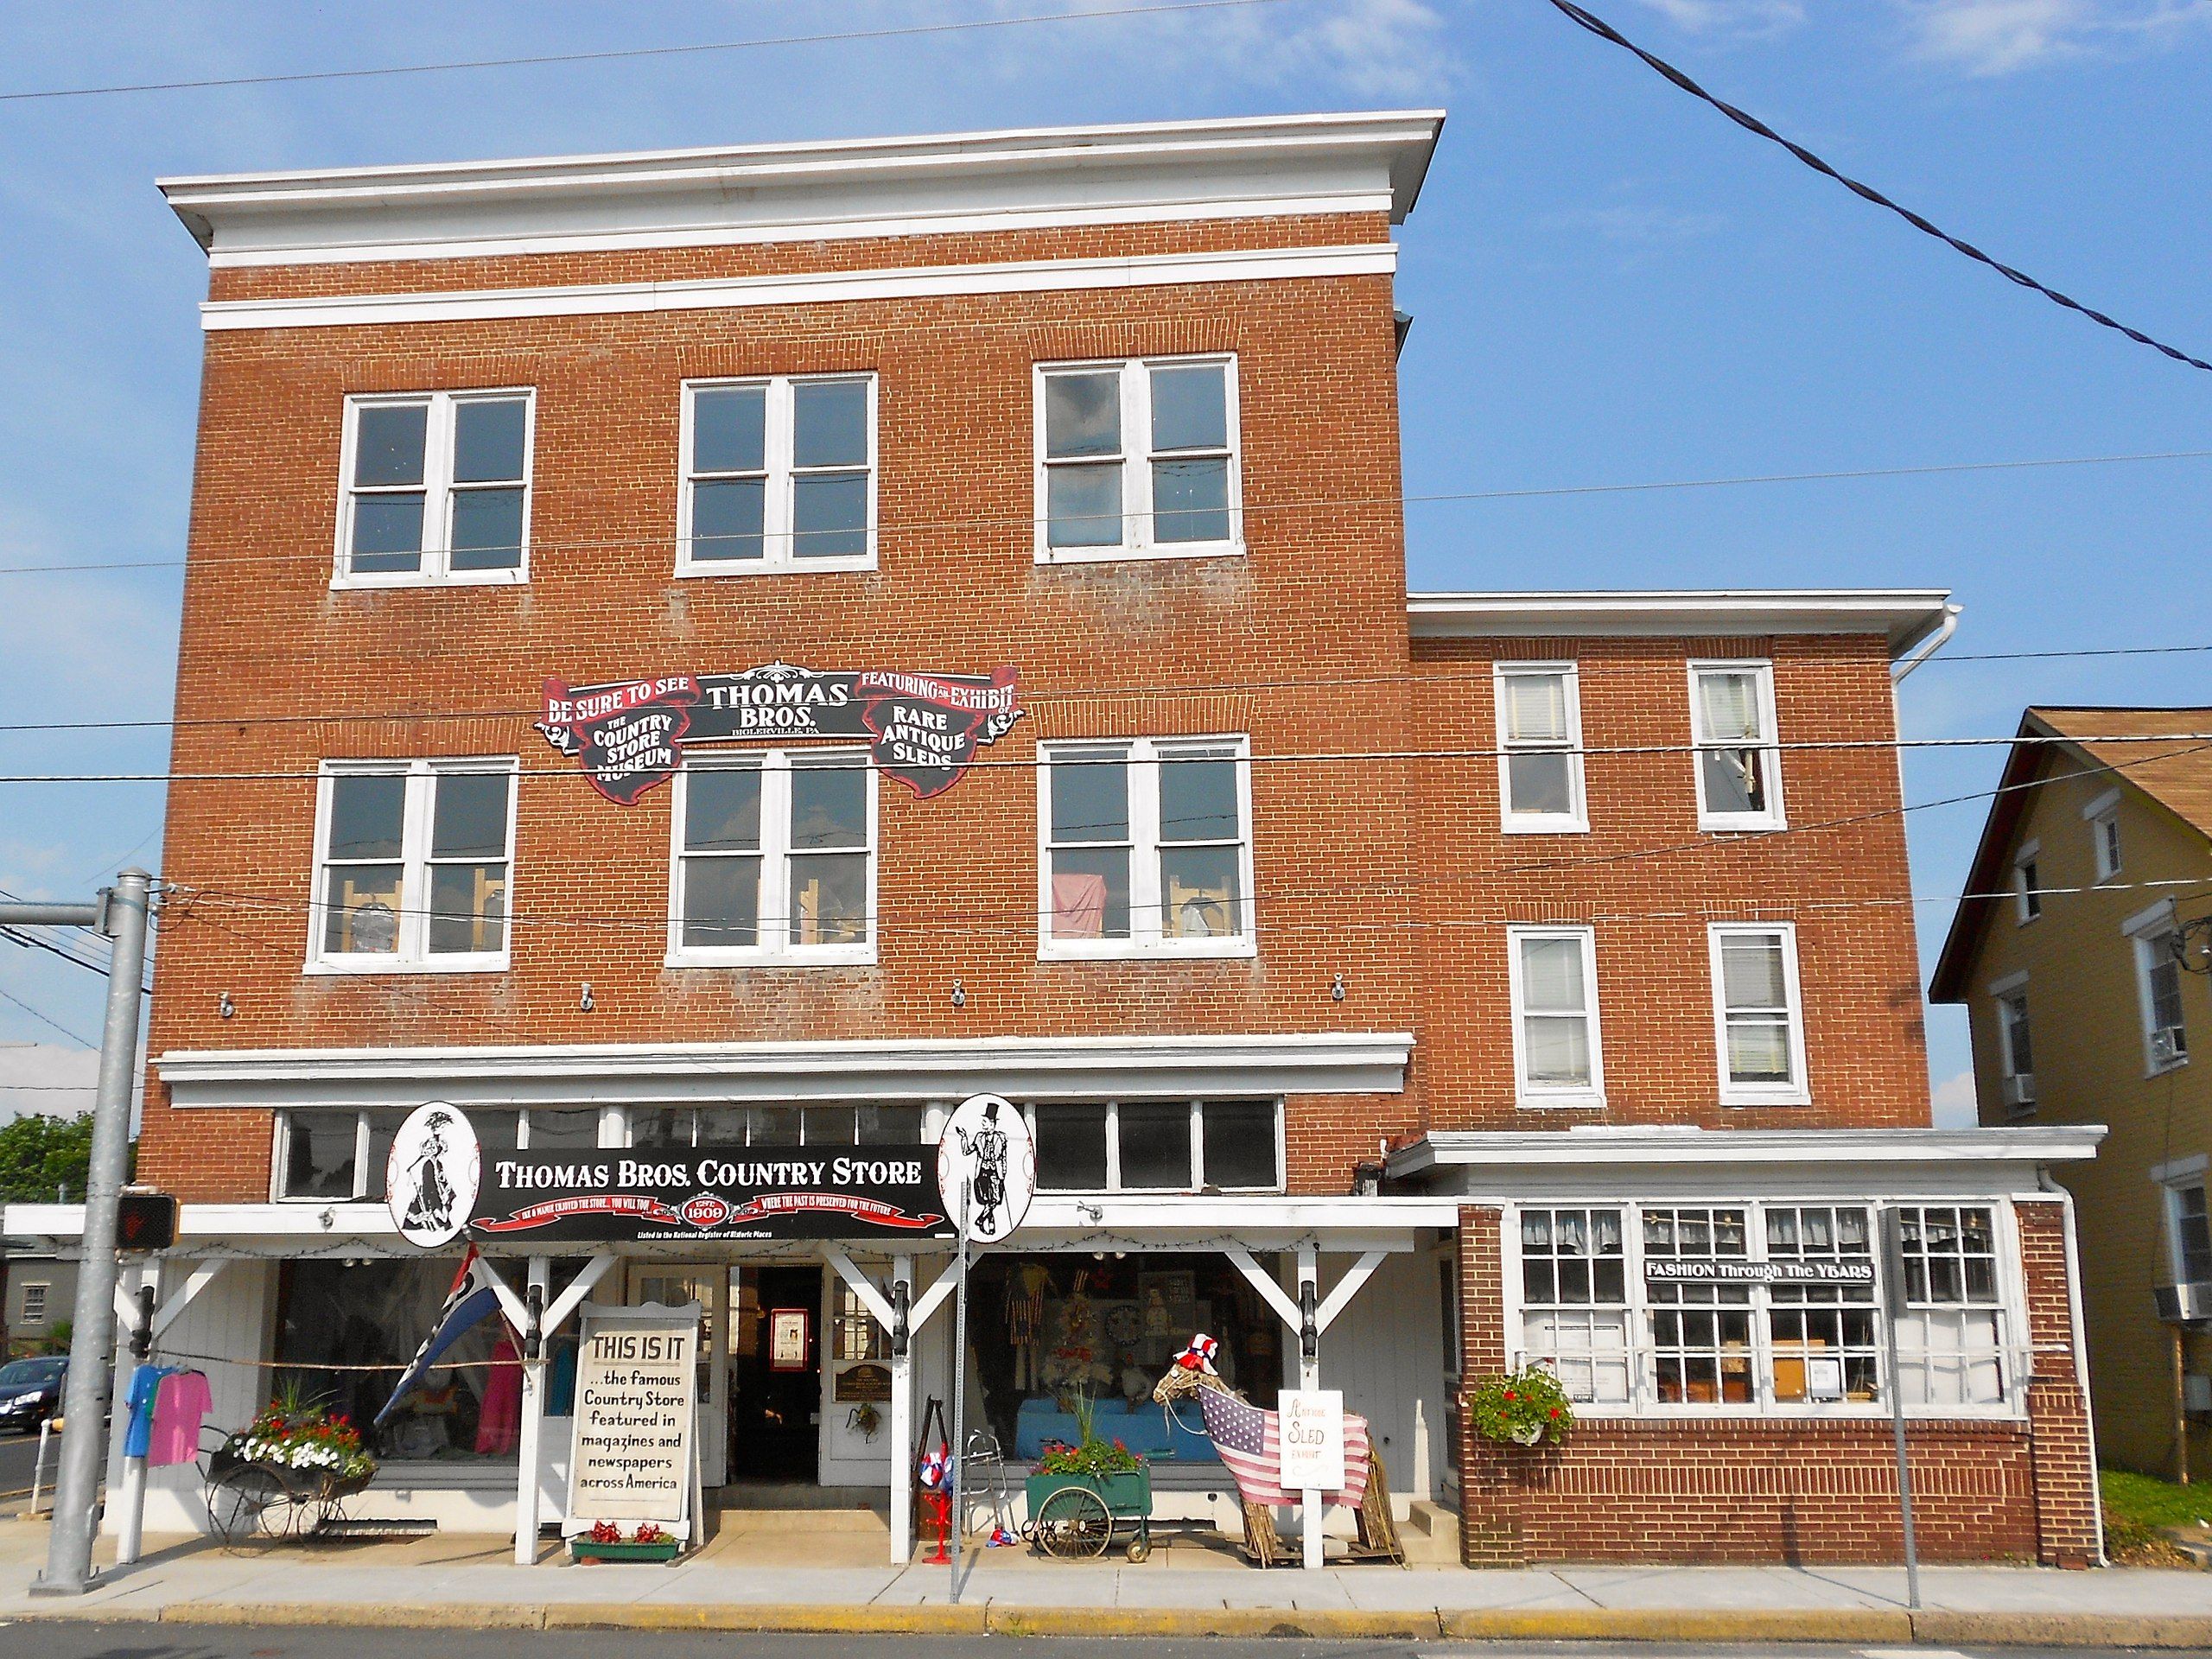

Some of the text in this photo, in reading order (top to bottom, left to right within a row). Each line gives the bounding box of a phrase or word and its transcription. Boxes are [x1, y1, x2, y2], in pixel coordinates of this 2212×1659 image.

[548, 677, 690, 722] BE SURE TO SEE
[706, 683, 849, 709] THOMAS
[861, 671, 938, 699] FEATURING
[950, 684, 1014, 709] EXHIBIT
[607, 715, 626, 730] THE
[740, 706, 817, 728] BROS.
[893, 705, 948, 731] RARE
[593, 714, 673, 747] COUNTRY
[805, 726, 820, 734] PA
[880, 724, 965, 753] ANTIQUE
[607, 731, 661, 764] STORE
[893, 742, 952, 771] SLEDS
[596, 747, 671, 781] MUSEUM
[495, 1157, 922, 1189] THOMAS BROS. COUNTRY STORE
[555, 1200, 579, 1212] ENJOYED
[578, 1198, 589, 1209] THE
[611, 1198, 622, 1209] YOU
[622, 1198, 636, 1210] WILL
[688, 1207, 723, 1219] 1909
[761, 1195, 892, 1216] WHERE THE PAST IS PRESERVED FOR THE FUTURE
[637, 1230, 656, 1239] Listed
[673, 1230, 697, 1239] National
[697, 1230, 722, 1240] Register
[1645, 1262, 1872, 1283] FASHION Through The YEARS
[592, 1336, 685, 1360] THIS IS IT
[630, 1370, 681, 1386] famous
[584, 1389, 684, 1410] Country Store
[589, 1410, 676, 1427] featured in
[582, 1433, 682, 1452] magazines and
[1287, 1421, 1325, 1445] SLED
[588, 1458, 672, 1471] newspapers
[580, 1473, 677, 1490] across America
